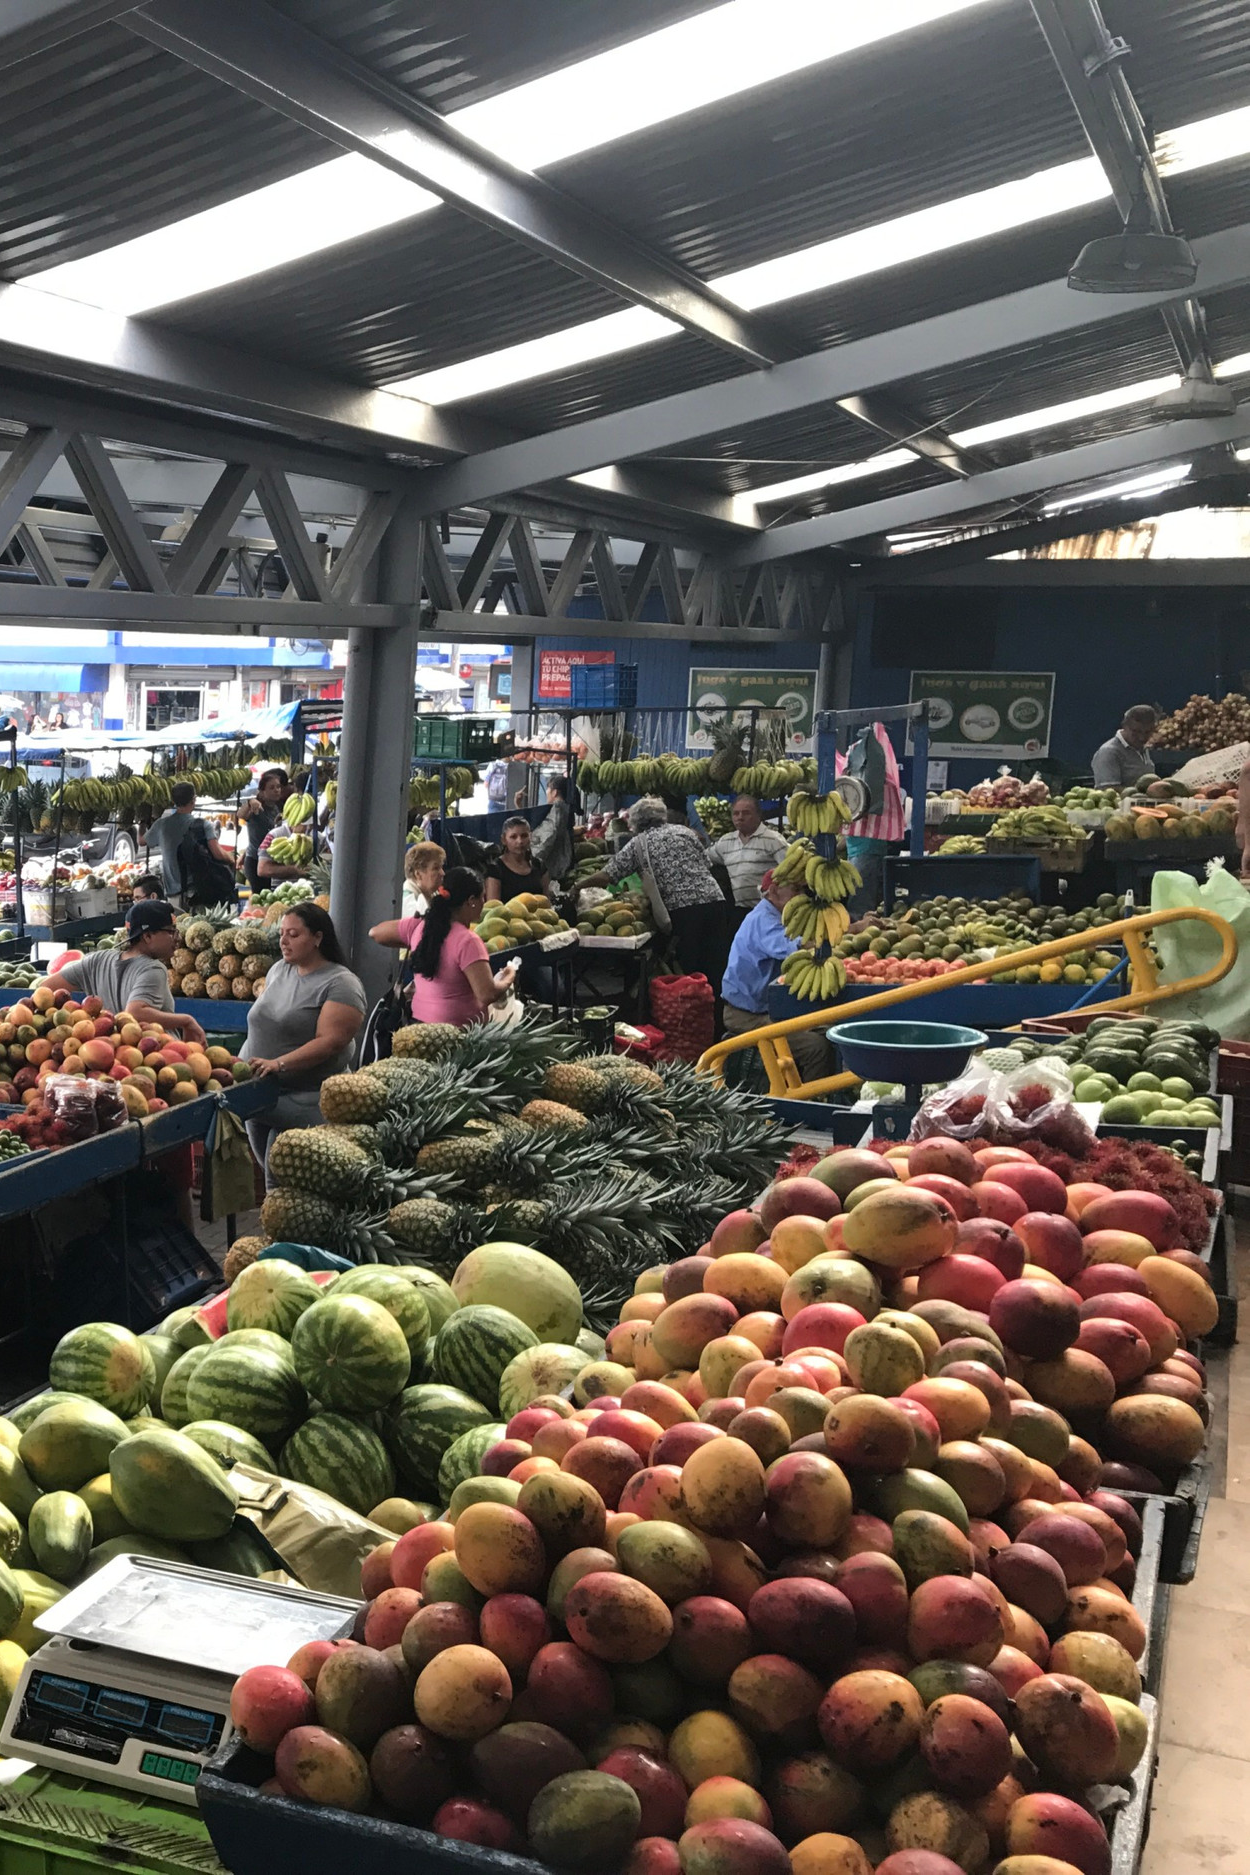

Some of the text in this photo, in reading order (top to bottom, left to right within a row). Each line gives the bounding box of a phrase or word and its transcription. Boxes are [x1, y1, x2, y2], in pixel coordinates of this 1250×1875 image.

[541, 656, 566, 664] ACTIVA
[541, 665, 570, 673] TU CHIP
[541, 673, 571, 682] PREPAG
